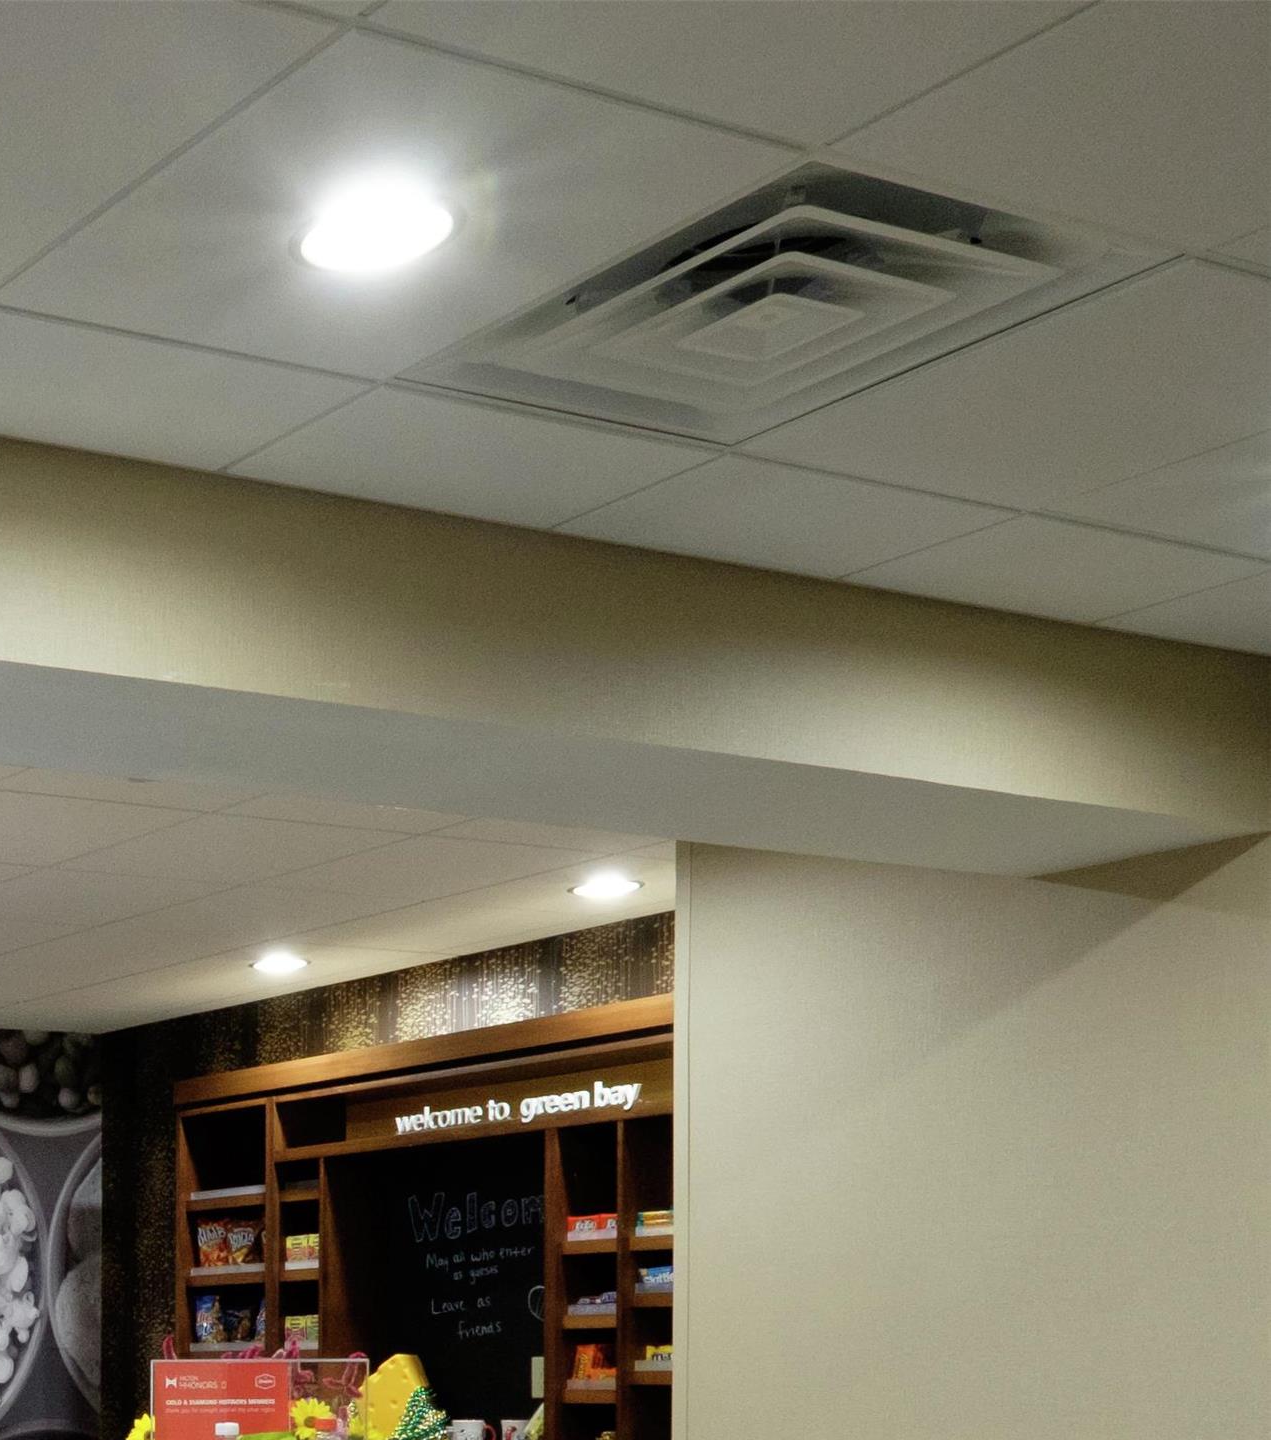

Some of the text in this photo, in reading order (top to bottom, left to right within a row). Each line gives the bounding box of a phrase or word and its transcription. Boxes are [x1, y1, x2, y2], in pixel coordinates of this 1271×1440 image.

[395, 1080, 643, 1135] welcome to green bay
[408, 1192, 545, 1242] Welcom
[470, 1248, 495, 1262] who
[431, 1296, 492, 1315] Leave as
[457, 1320, 504, 1339] friends
